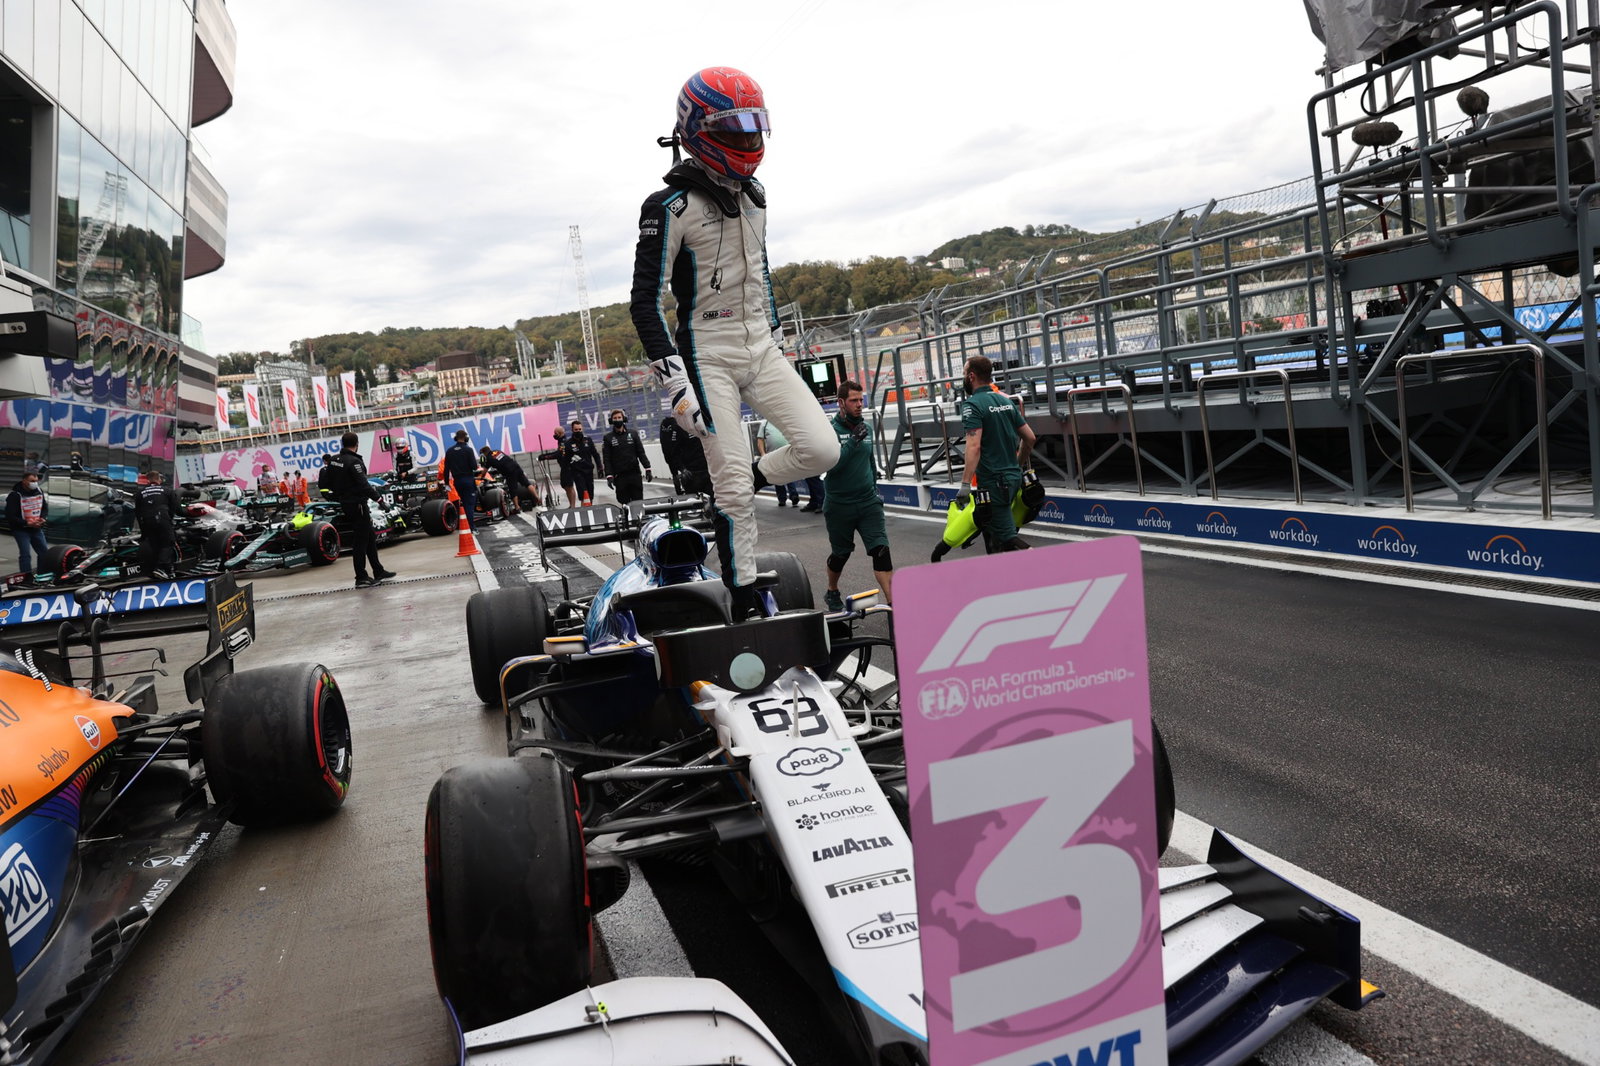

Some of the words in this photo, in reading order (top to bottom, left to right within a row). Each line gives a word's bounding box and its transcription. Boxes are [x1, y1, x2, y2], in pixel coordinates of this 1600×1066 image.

[703, 312, 719, 320] OMP
[280, 439, 343, 459] CHANG
[297, 457, 324, 470] WO
[126, 565, 140, 575] IWC
[21, 578, 216, 622] DAKTRAC
[916, 573, 1128, 674] F1
[971, 676, 998, 694] FIA
[1001, 663, 1065, 687] Formula
[1067, 660, 1077, 675] 1
[972, 686, 1021, 710] World
[748, 697, 829, 737] 63
[82, 723, 98, 738] Gulf
[790, 753, 830, 770] pax8
[787, 786, 866, 807] BLACKBIRD.AI
[820, 804, 874, 821] honibe
[812, 835, 894, 863] LAVAZZA
[824, 867, 912, 899] PIRELLI
[928, 718, 1143, 1034] 3
[856, 920, 918, 945] SOFIN
